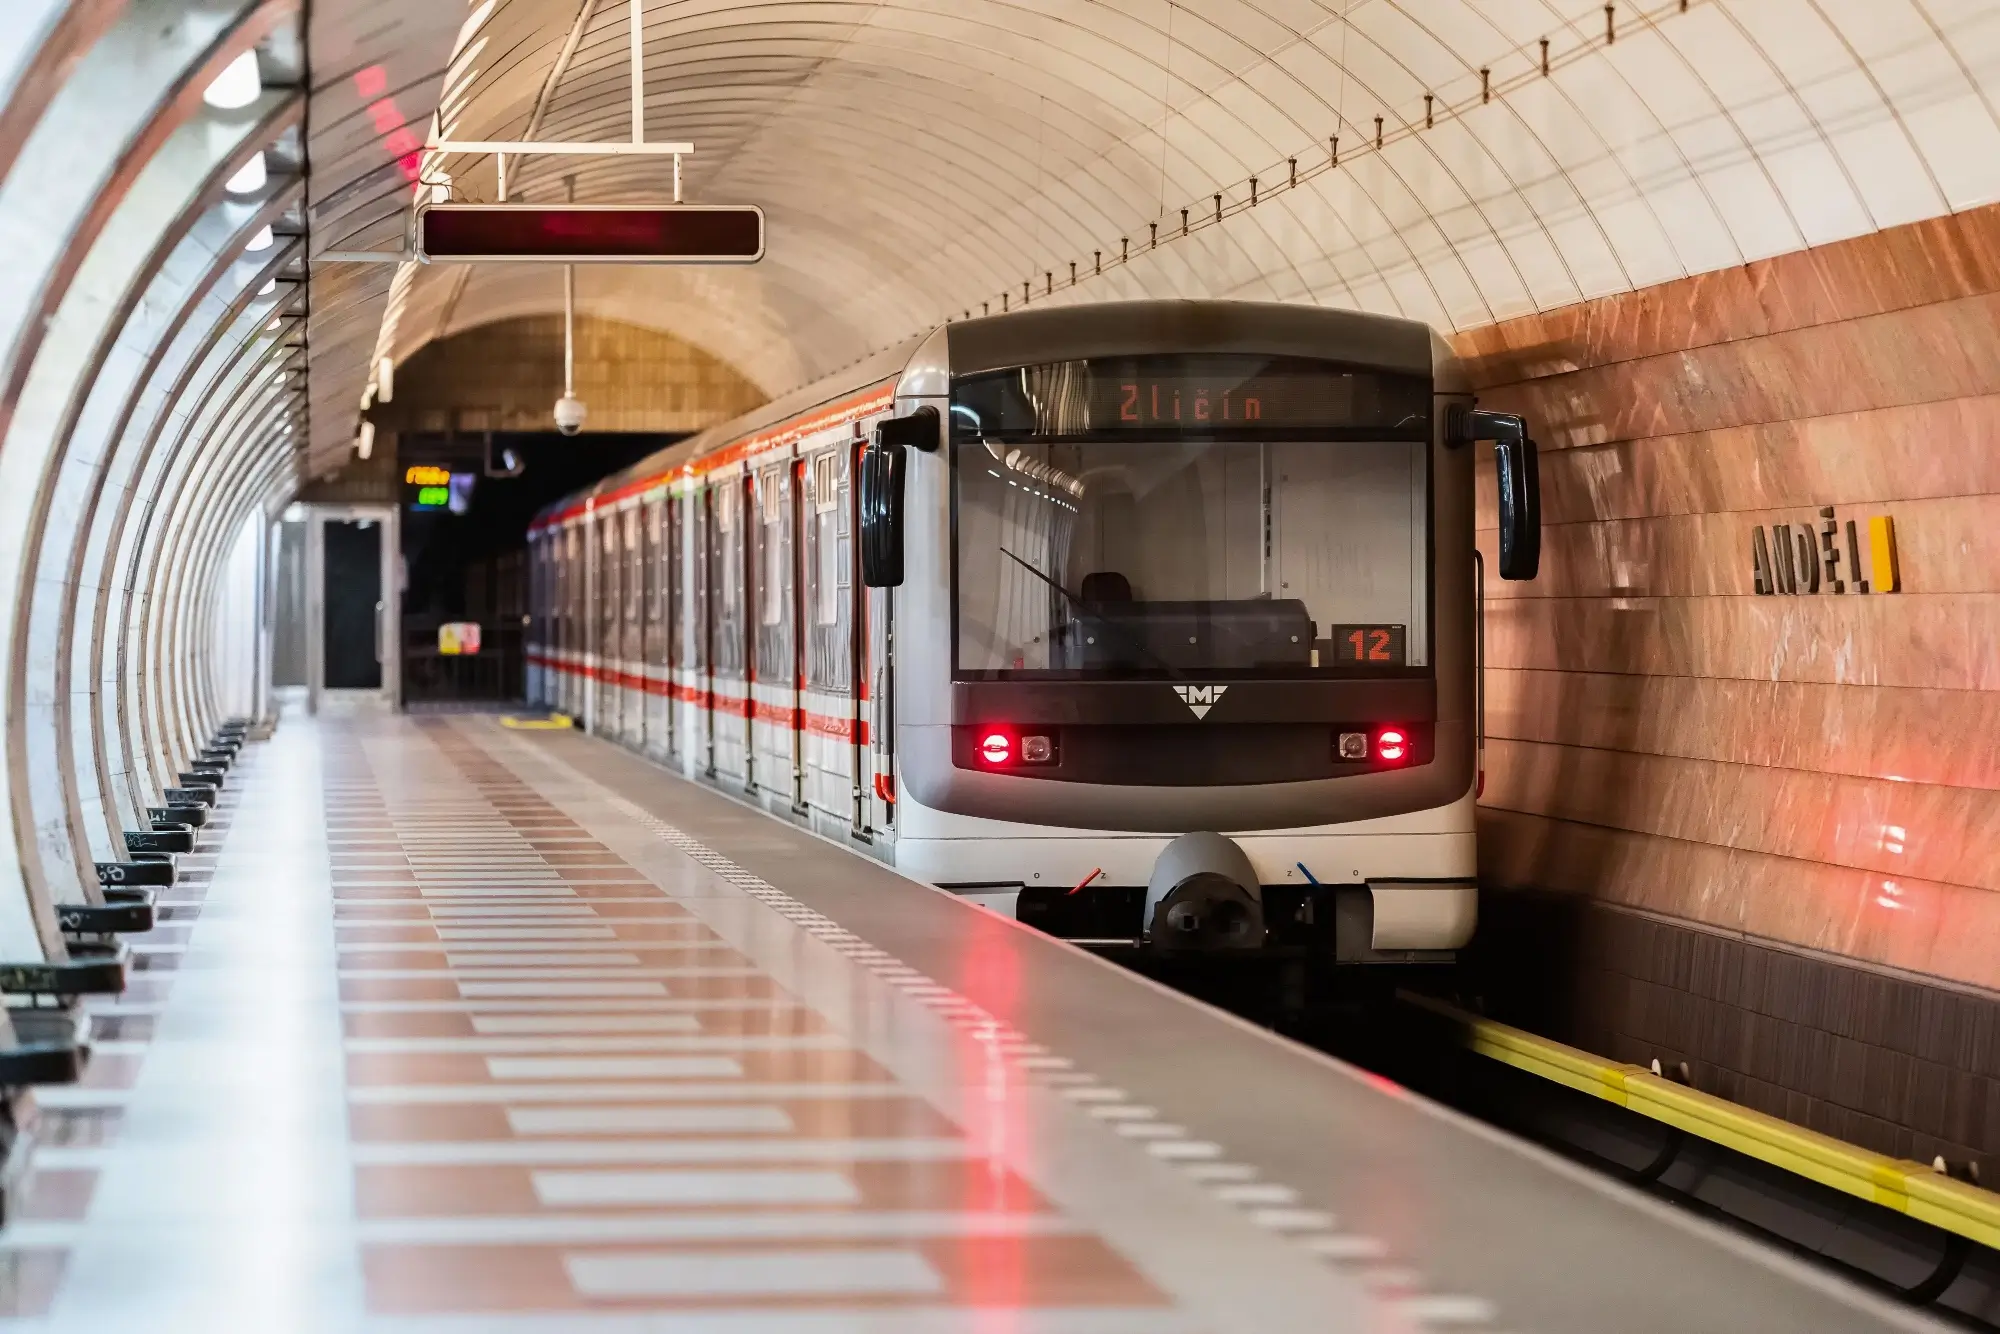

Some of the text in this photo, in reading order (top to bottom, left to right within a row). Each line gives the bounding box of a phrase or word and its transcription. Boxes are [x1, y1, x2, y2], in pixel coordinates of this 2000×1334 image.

[1121, 384, 1260, 420] Zličín
[1752, 506, 1869, 595] ANDĚL
[1348, 630, 1390, 660] 12
